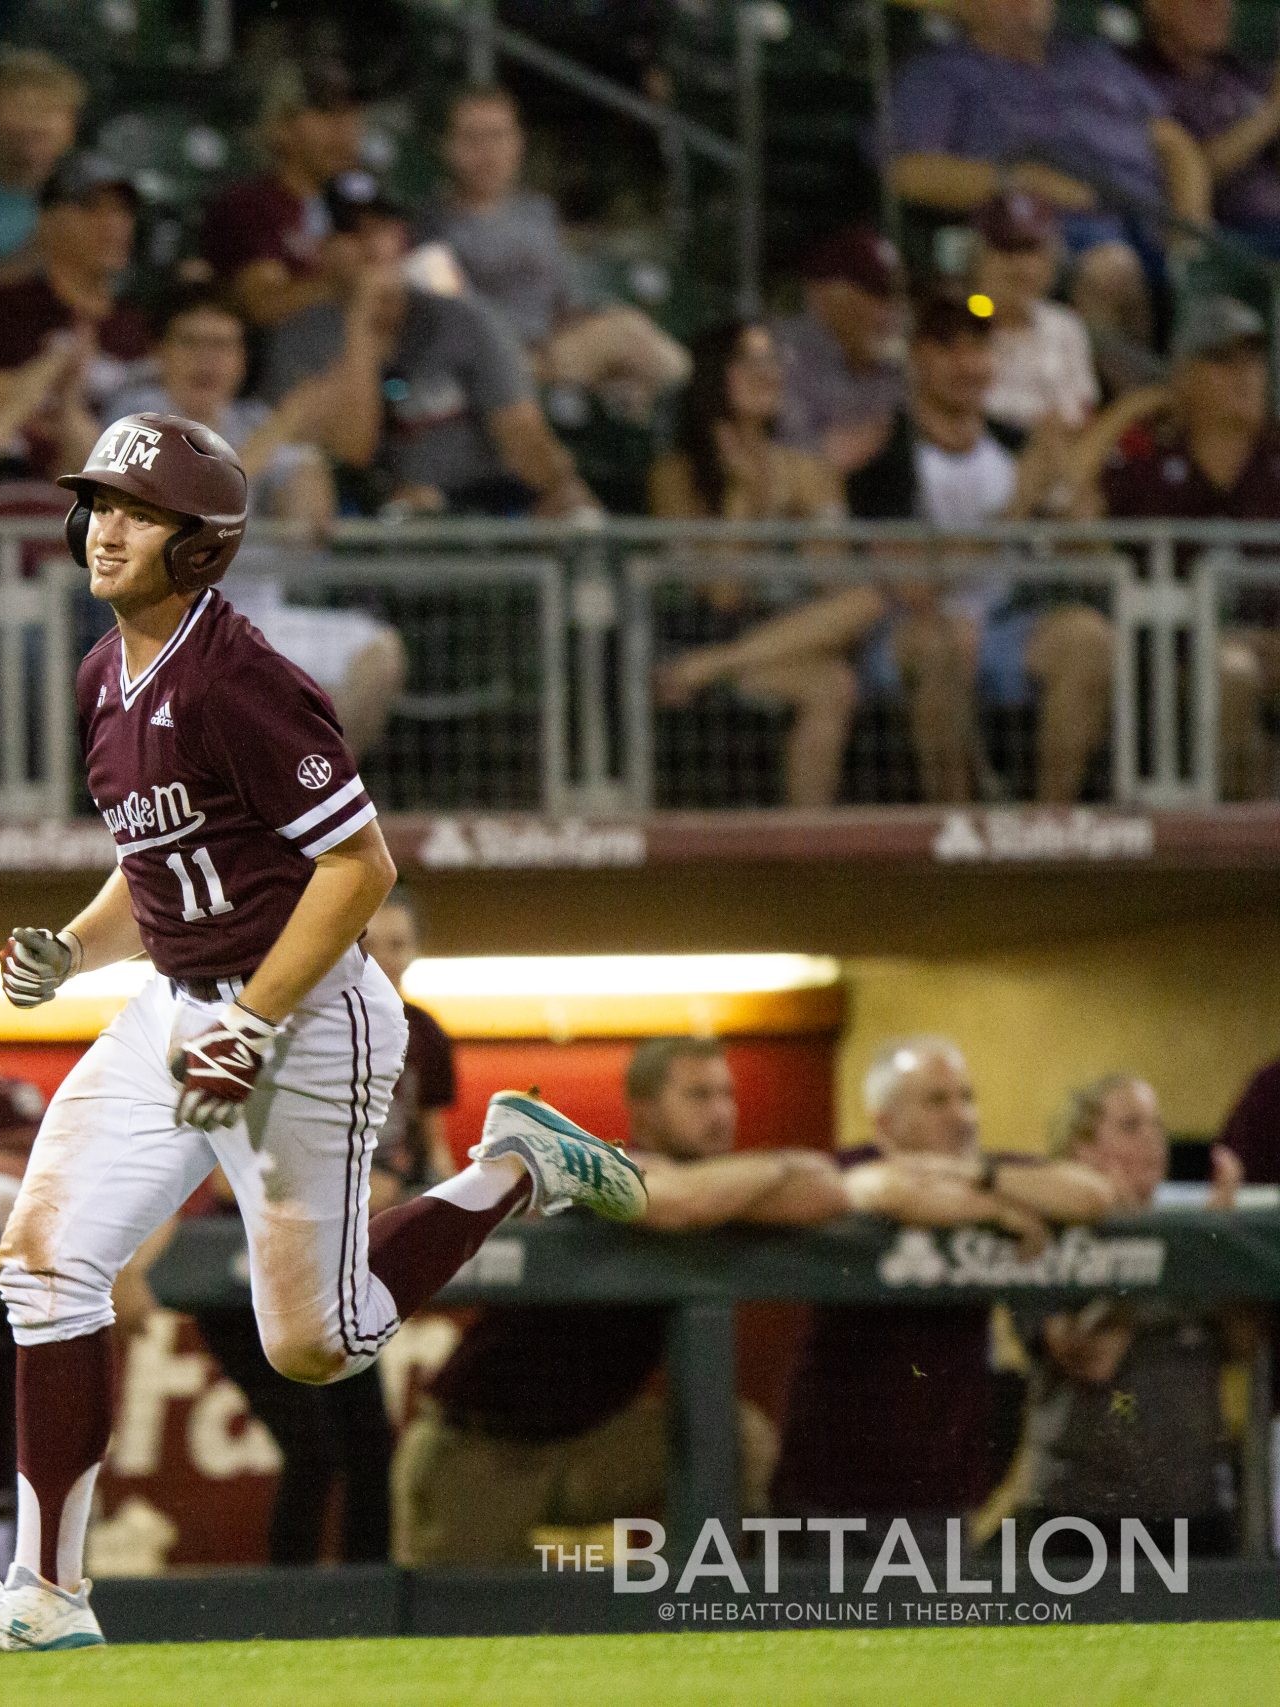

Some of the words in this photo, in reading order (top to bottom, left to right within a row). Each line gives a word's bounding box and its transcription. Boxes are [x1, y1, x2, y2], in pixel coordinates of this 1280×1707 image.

[150, 715, 174, 728] adidas
[298, 755, 331, 789] SEC
[166, 847, 234, 922] 11
